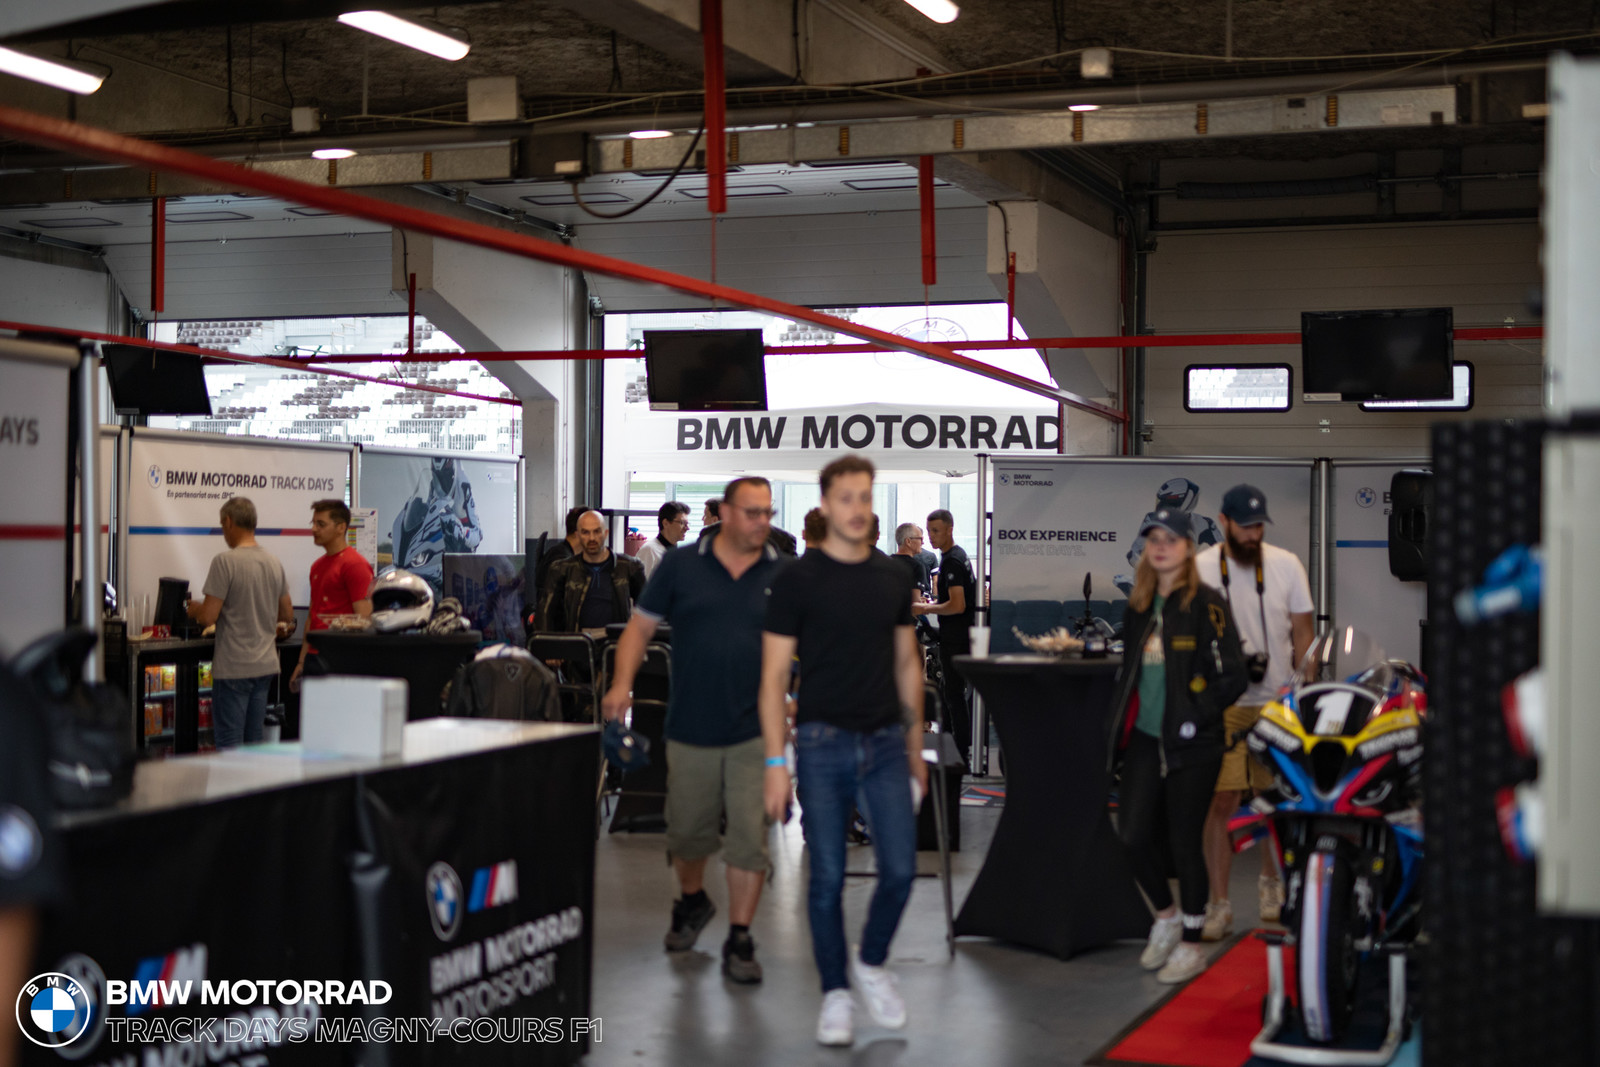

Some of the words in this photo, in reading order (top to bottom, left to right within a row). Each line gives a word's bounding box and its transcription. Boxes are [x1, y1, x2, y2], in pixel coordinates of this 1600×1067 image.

[676, 416, 787, 450] BMW
[801, 414, 1059, 450] MOTORRAD
[166, 471, 197, 485] BMW
[201, 472, 267, 489] MOTORRAD
[271, 475, 305, 491] TRACK
[307, 477, 334, 491] DAYS
[998, 529, 1027, 541] BOX
[1030, 530, 1117, 542] EXPERIENCE
[998, 543, 1044, 555] TRACK
[1313, 690, 1355, 735] 1
